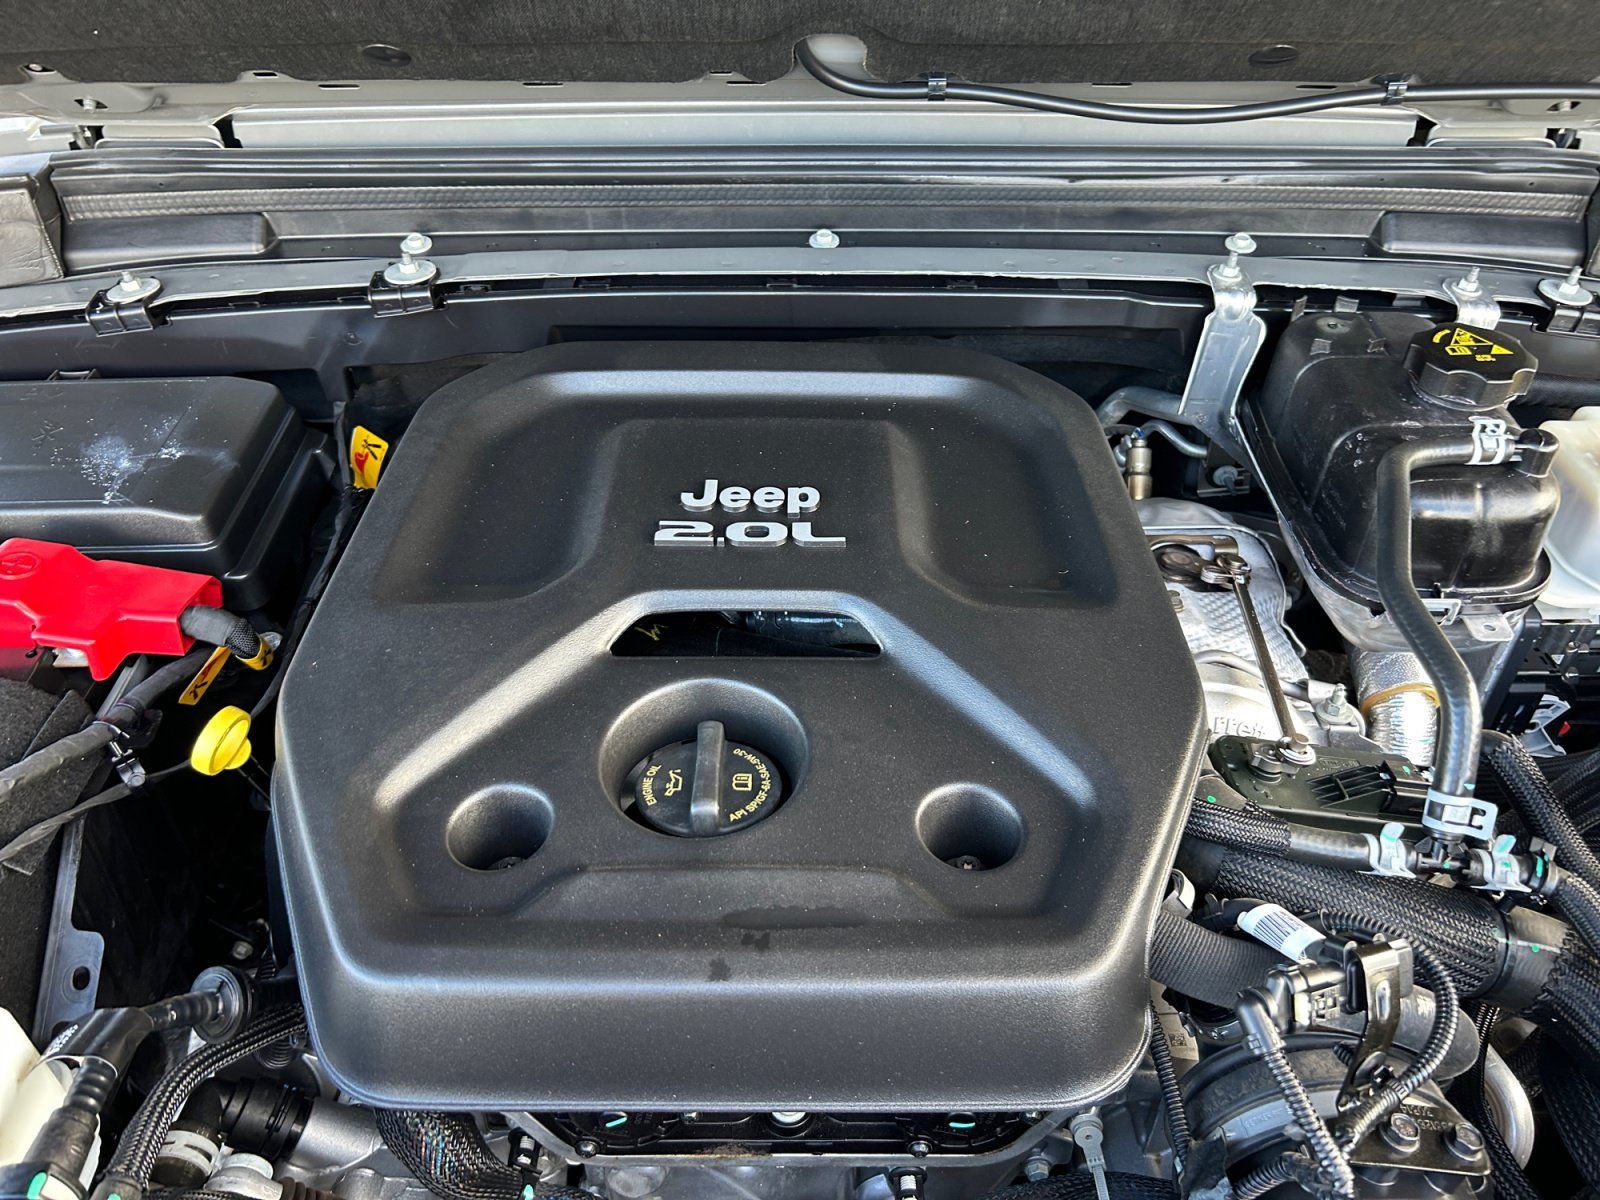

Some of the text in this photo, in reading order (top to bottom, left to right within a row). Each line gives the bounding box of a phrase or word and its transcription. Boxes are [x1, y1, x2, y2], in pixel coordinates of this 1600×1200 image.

[681, 479, 820, 518] Jeep
[654, 520, 846, 547] 2.0L
[642, 764, 662, 806] ENGINE OIL
[729, 809, 748, 822] API
